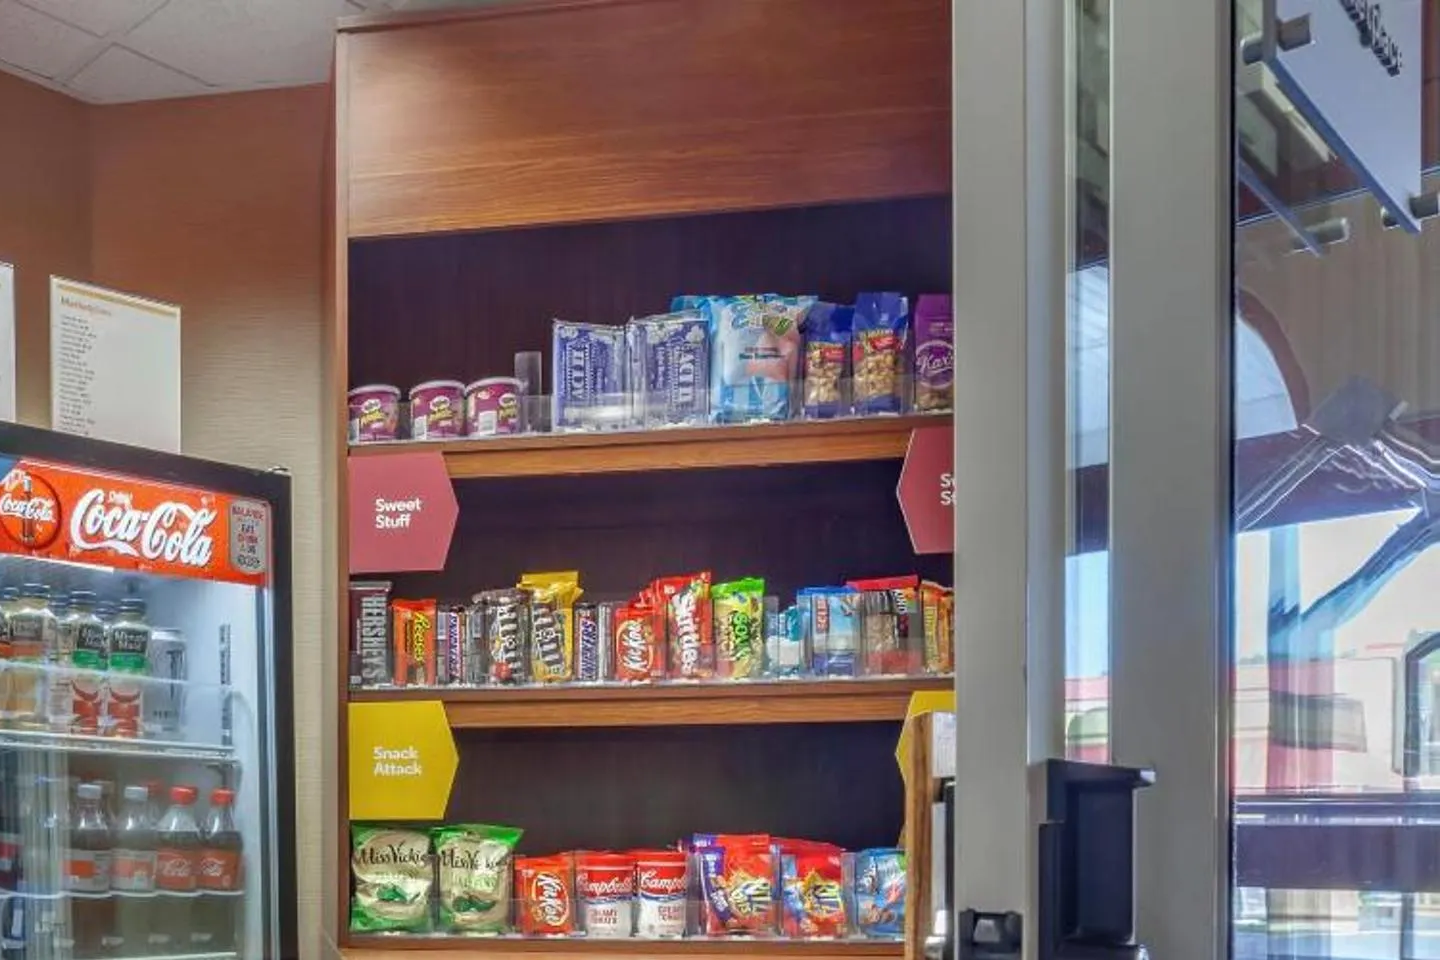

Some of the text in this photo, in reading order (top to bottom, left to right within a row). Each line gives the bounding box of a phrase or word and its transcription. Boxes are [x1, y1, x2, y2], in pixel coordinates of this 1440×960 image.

[375, 498, 421, 512] Sweet
[70, 488, 217, 568] Coca-Cola
[375, 513, 411, 529] Stuff
[362, 595, 388, 686] HERSHEY'S
[672, 592, 699, 675] Skittles
[373, 745, 419, 760] Snack
[374, 761, 422, 777] Attack
